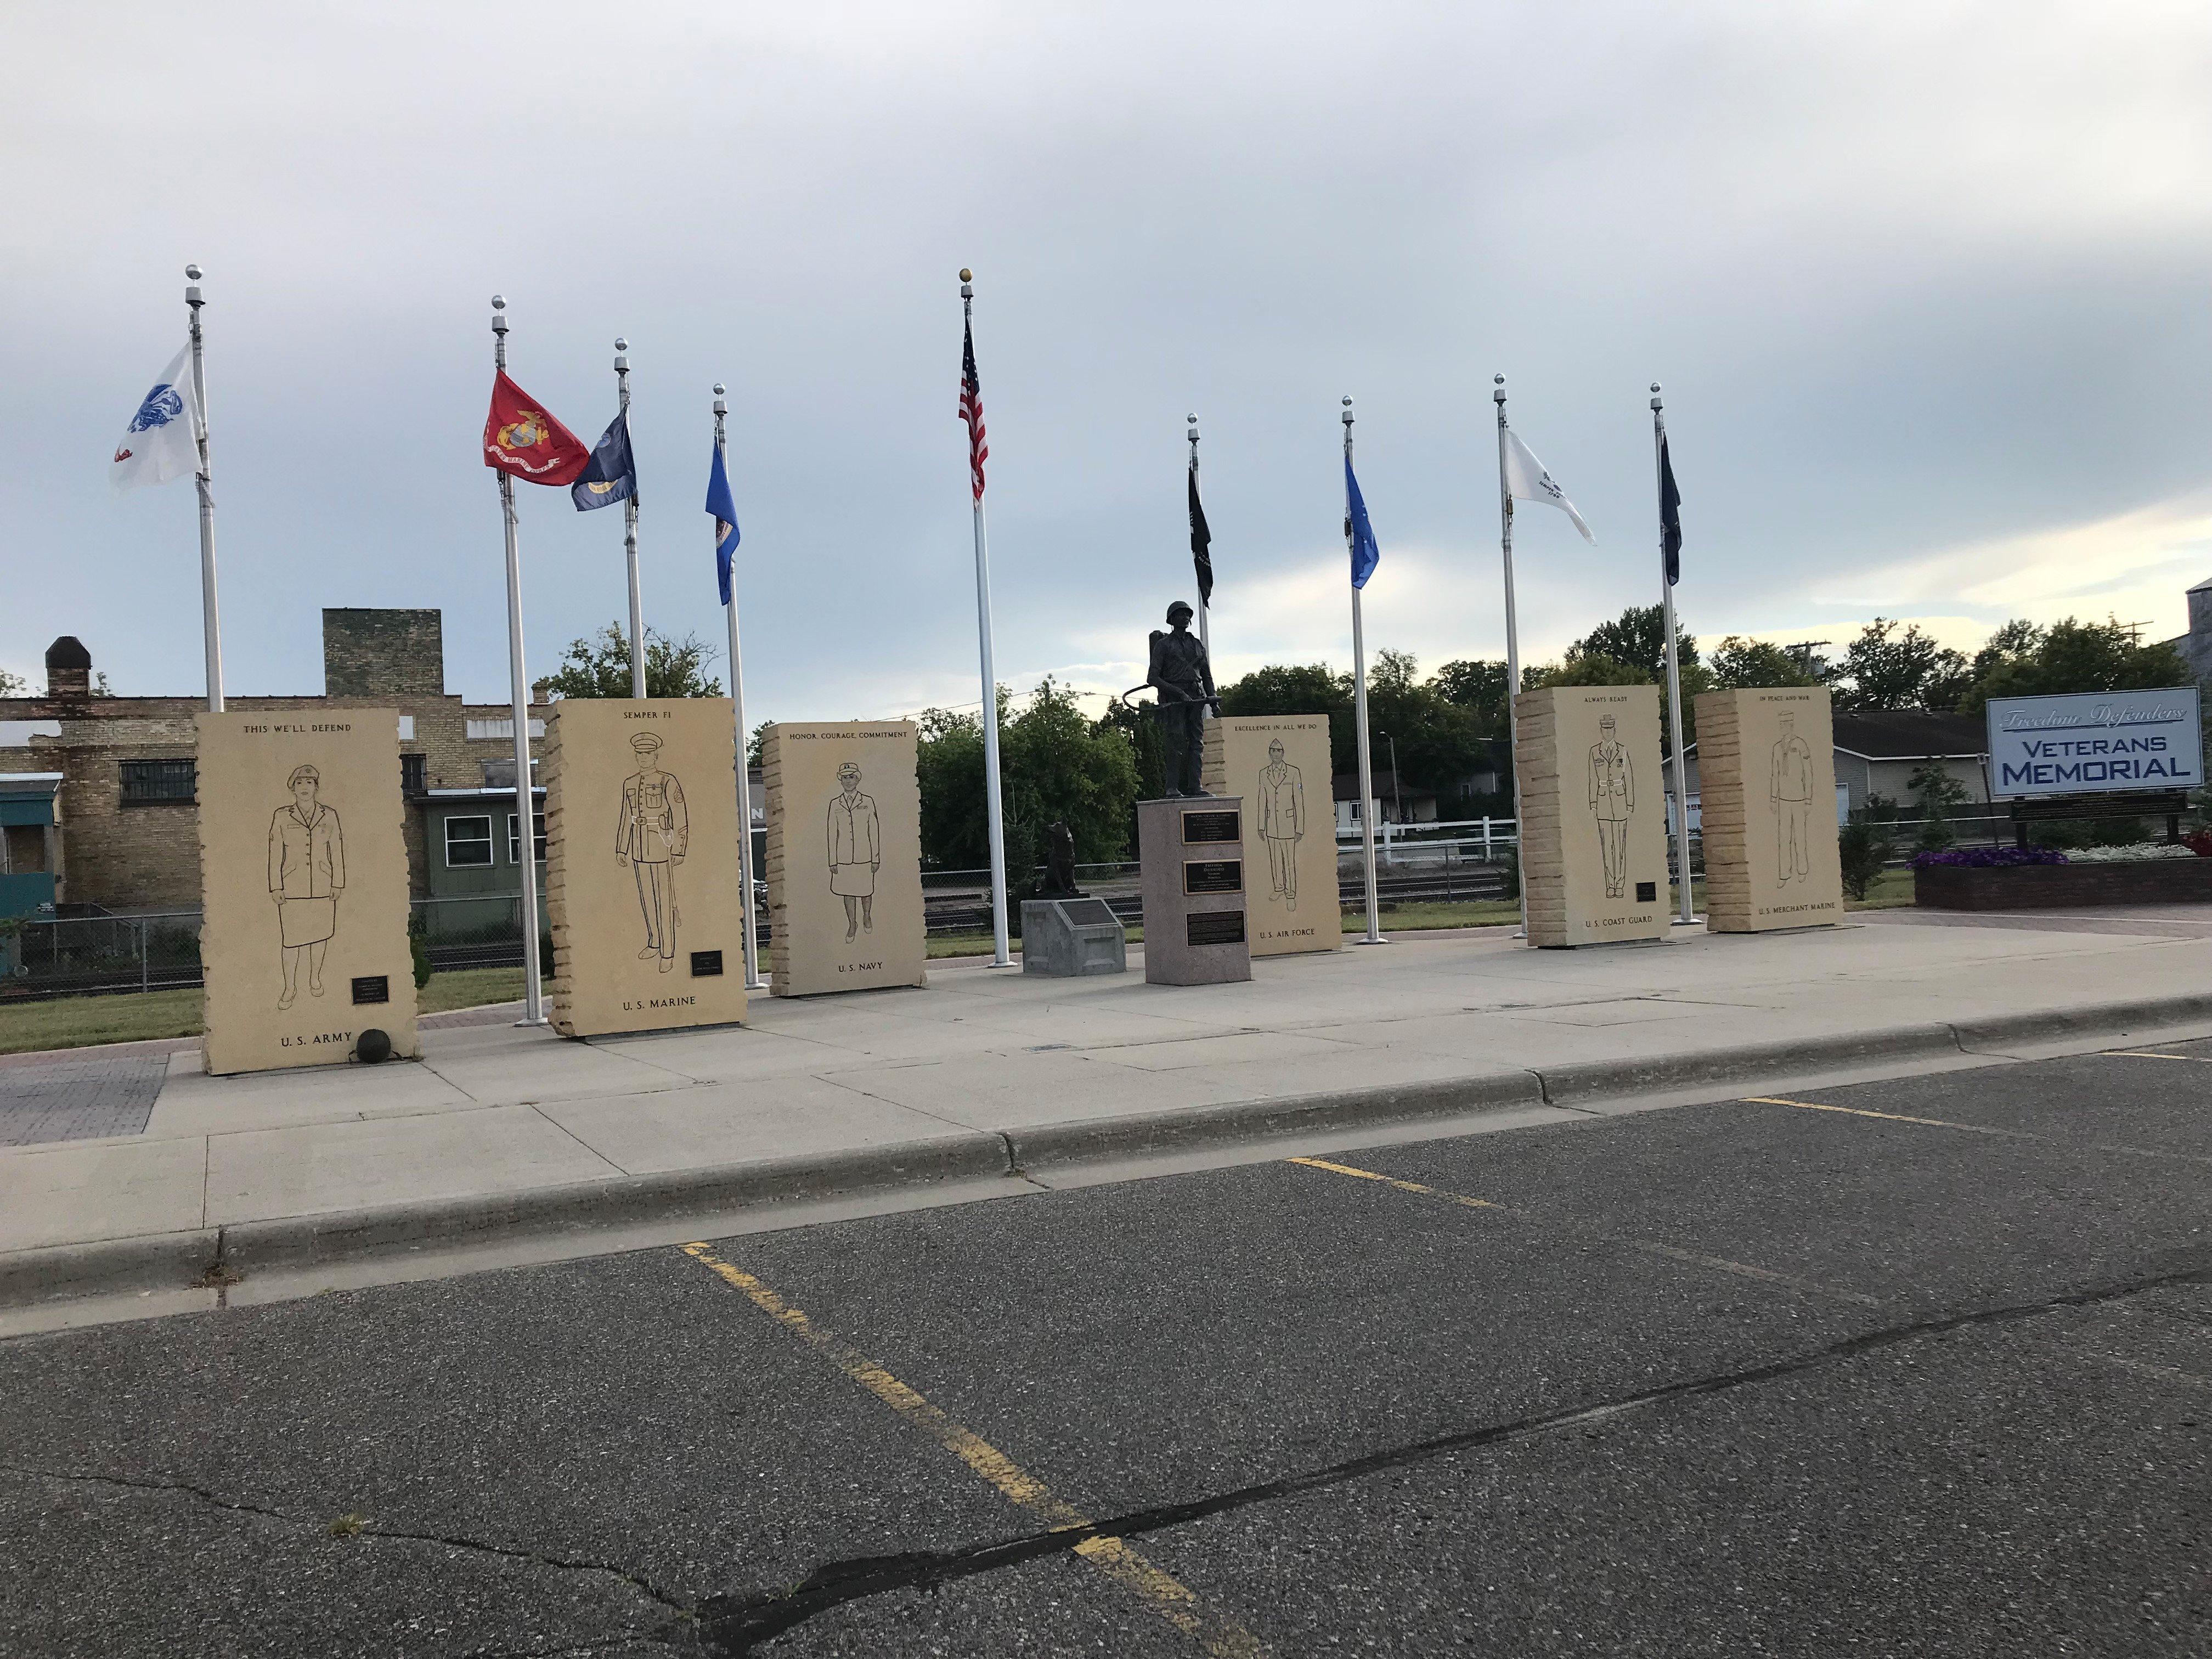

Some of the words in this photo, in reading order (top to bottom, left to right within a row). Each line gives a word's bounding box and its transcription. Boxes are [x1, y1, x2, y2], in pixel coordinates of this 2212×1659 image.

[1999, 710, 2083, 729] Freedom
[2090, 703, 2187, 728] Defenders
[244, 725, 268, 733] THIS
[2021, 736, 2168, 758] VETERANS
[2002, 757, 2191, 786] MEMORIAL
[1774, 905, 1808, 913] MERCHANT
[1811, 902, 1835, 910] MARINE
[1603, 918, 1625, 926] COAST
[1628, 916, 1652, 924] GUARD
[859, 962, 882, 970] NAVY
[623, 1002, 633, 1011] U.
[637, 1001, 645, 1009] S.
[650, 996, 696, 1008] MARINE
[281, 1037, 292, 1047] U.
[297, 1036, 306, 1046] S.
[313, 1032, 352, 1044] ARMY
